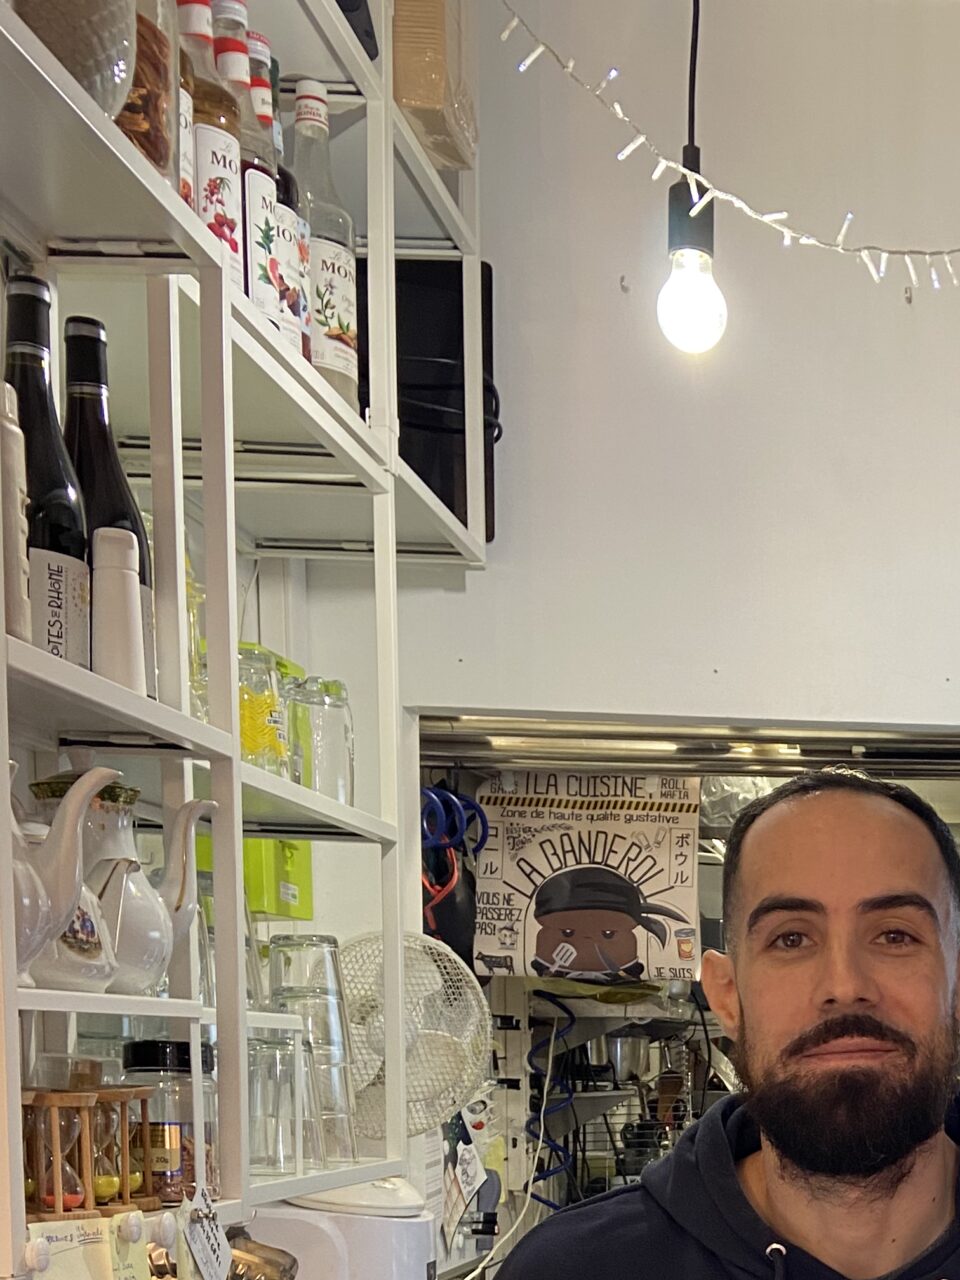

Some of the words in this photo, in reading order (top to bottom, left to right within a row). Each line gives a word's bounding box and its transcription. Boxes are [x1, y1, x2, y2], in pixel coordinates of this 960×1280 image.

[660, 777, 689, 790] ROLL
[660, 790, 689, 800] MAFIA
[500, 806, 527, 818] Zone
[530, 808, 545, 819] de
[549, 809, 583, 821] haute
[624, 811, 680, 824] gustative
[674, 832, 690, 885] ボウル
[475, 891, 500, 906] VOUS
[502, 892, 516, 907] NE
[475, 908, 523, 922] PASSEREZ
[475, 921, 496, 936] PAS!
[653, 966, 666, 978] JE
[668, 967, 693, 979] SUIS
